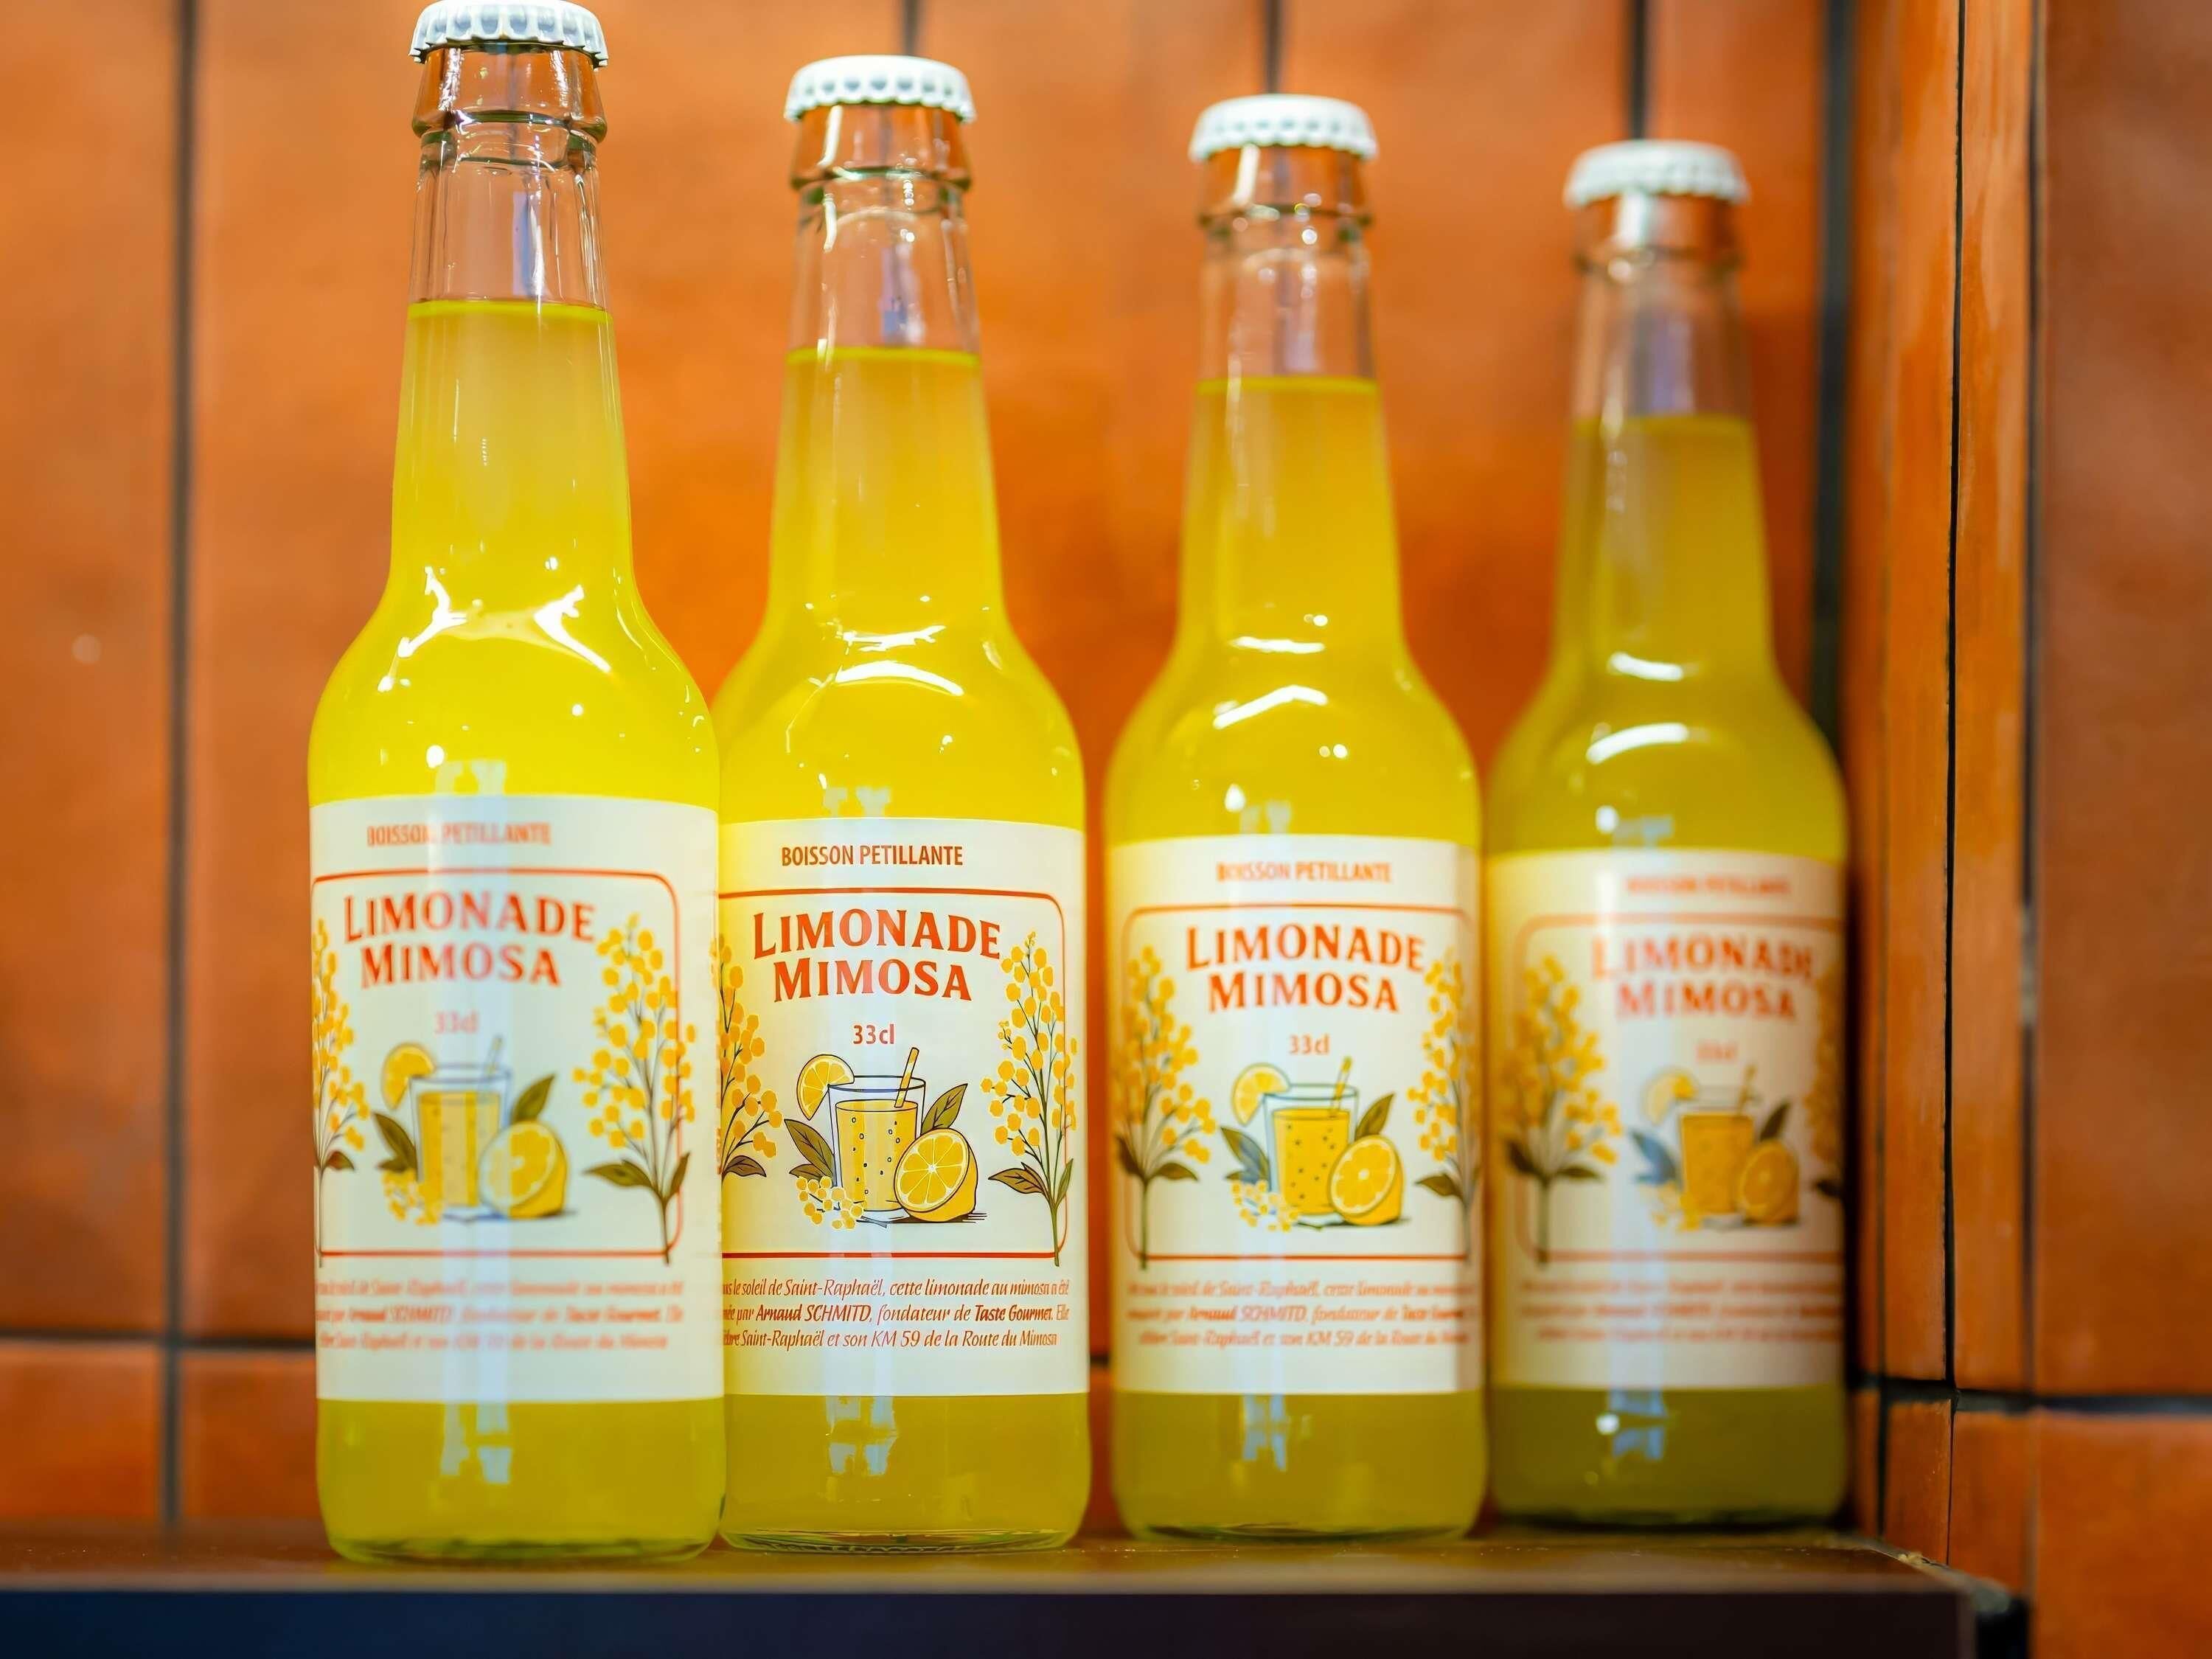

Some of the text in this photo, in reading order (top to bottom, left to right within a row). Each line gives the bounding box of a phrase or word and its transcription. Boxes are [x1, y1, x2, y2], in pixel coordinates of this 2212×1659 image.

[781, 844, 964, 866] BOISSON PETILLANTE
[1295, 861, 1391, 883] PETILLANTE
[344, 890, 596, 943] LIMONADE
[753, 908, 1001, 960] LIMONADE
[1186, 924, 1424, 972] LIMONADE
[361, 942, 563, 990] MIMOSA
[773, 957, 973, 1003] MIMOSA
[1208, 971, 1398, 1013] MIMOSA
[1616, 980, 1796, 1022] MIMOSA
[852, 1023, 895, 1046] 33cl
[1288, 1034, 1330, 1055] 33cl
[733, 1279, 741, 1295] le
[742, 1278, 767, 1295] soleil
[768, 1279, 782, 1295] de
[784, 1278, 885, 1301] Saint-Raphaël,
[890, 1282, 923, 1295] cette
[925, 1278, 990, 1295] limonade
[991, 1283, 1009, 1295] au
[1010, 1279, 1050, 1295] mimosa
[736, 1308, 754, 1326] par
[756, 1304, 803, 1321] Arnaud
[804, 1304, 873, 1324] SCHMITD,
[876, 1304, 950, 1326] fondateur
[954, 1304, 972, 1321] de
[975, 1304, 1006, 1321] Taste
[741, 1329, 825, 1352] Saint-Raphaël
[827, 1332, 841, 1347] et
[843, 1333, 868, 1347] son
[871, 1329, 898, 1347] KM
[900, 1329, 920, 1348] 59
[923, 1329, 942, 1347] de
[944, 1329, 959, 1346] la
[961, 1329, 1000, 1346] Route
[1001, 1329, 1018, 1346] du
